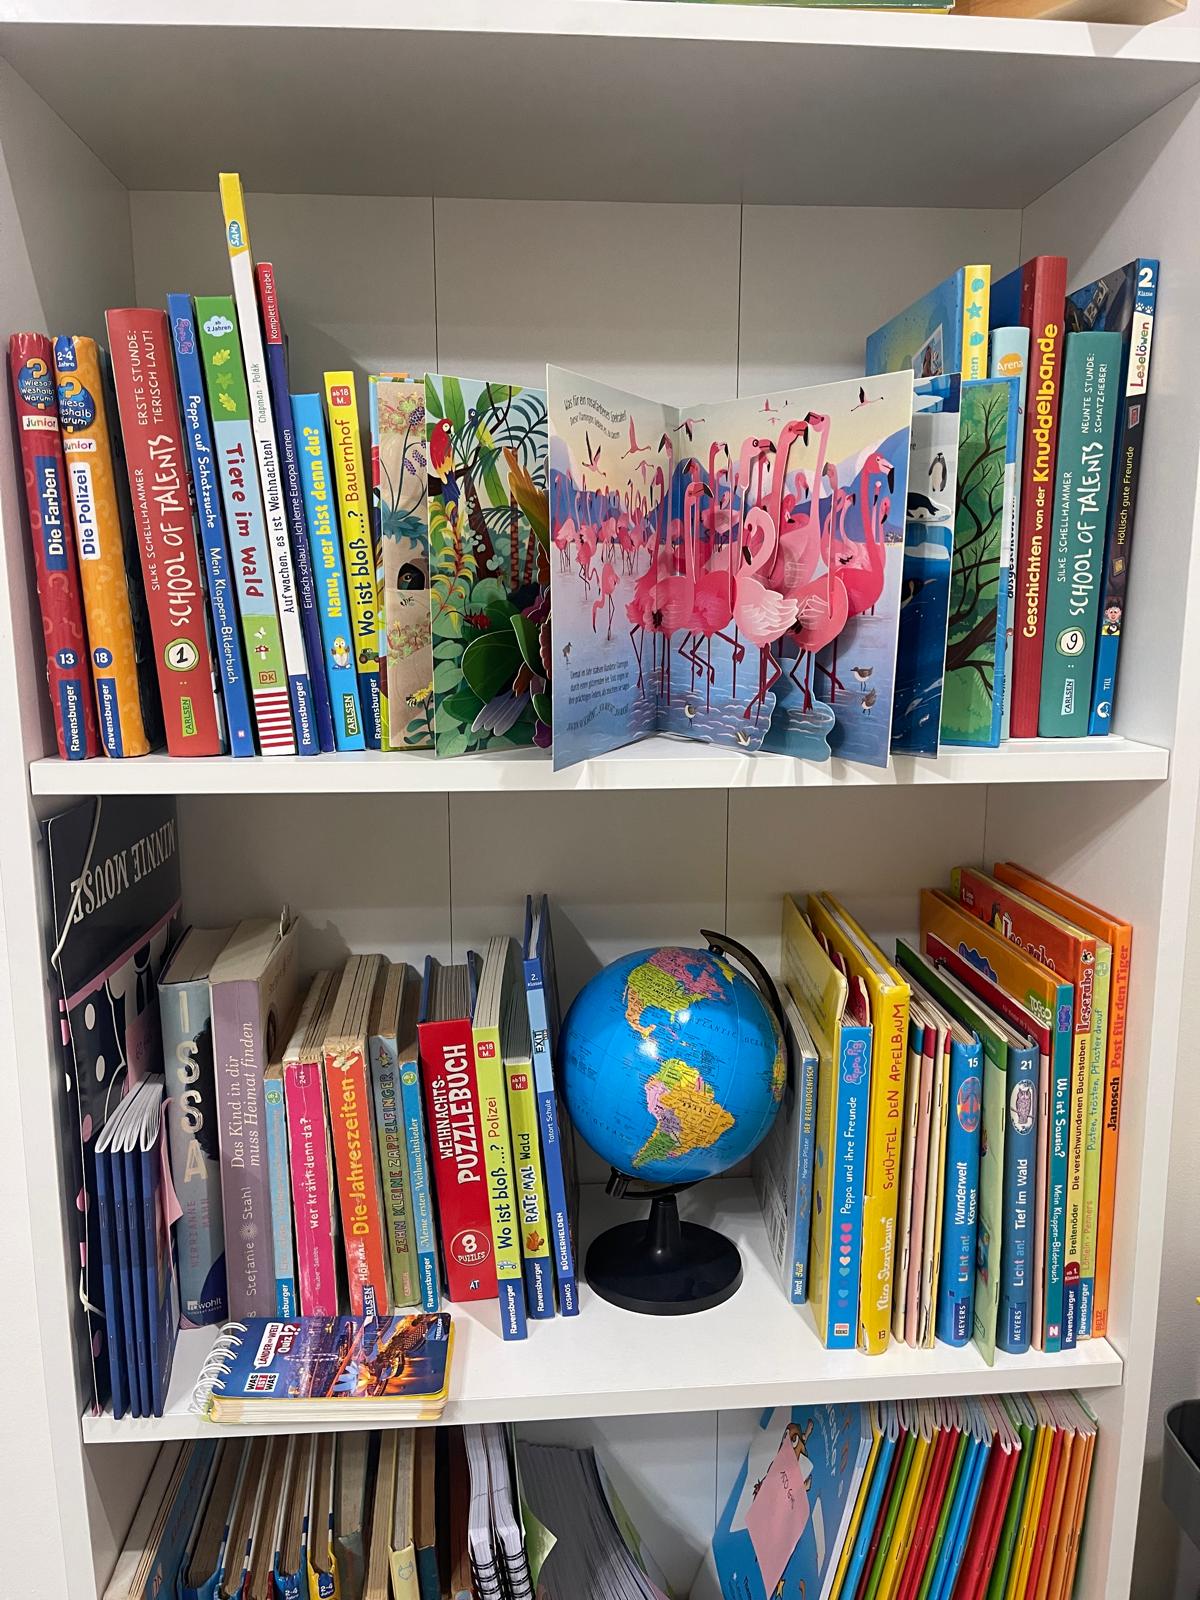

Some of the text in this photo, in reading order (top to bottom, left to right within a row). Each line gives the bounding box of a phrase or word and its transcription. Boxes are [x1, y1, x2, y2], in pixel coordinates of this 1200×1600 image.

[211, 324, 232, 332] Jahren
[264, 269, 278, 340] Komplett in Farbe!
[127, 329, 148, 426] ERSTE STUNDE:
[142, 330, 163, 425] TIERISCH LAUT!
[997, 359, 1024, 371] Arena
[1130, 322, 1150, 388] Leselöwen
[252, 390, 267, 423] Chapman
[1081, 353, 1095, 434] NEUNTE STUNDE:
[1095, 363, 1108, 434] SCHATZFIEBER!
[187, 395, 214, 528] Peppa auf Schatzsuche
[260, 440, 285, 547] es ist Weihnachten!
[1023, 323, 1058, 638] Geschichten von der Knuddelbande
[42, 468, 63, 555] Die Farben
[73, 469, 96, 555] Die Polizei
[135, 468, 160, 590] SILKE SCHELLHAMMER
[226, 442, 264, 597] Tiere im Wald
[284, 429, 313, 609] Einfach schlau! Ich lerne Europa kennen
[303, 427, 343, 617] Nanu, wer bist denn du?
[335, 420, 375, 637] Wo ist Bauernhof
[1057, 471, 1073, 583] SILKE SCHELLHAMMER
[1070, 441, 1105, 616] SCHOOL OF TALENTS
[1117, 446, 1134, 545] Höllisch gute Freunde
[148, 434, 196, 627] SCHOOL OF TALENTS
[210, 547, 239, 684] Mein Klappen-Bilderbuch
[59, 653, 75, 665] 13
[95, 652, 108, 663] 18
[261, 673, 275, 682] DK
[66, 684, 80, 751] Ravensburger
[101, 683, 116, 750] Ravensburger
[182, 698, 194, 736] CARLSEN
[296, 681, 311, 745] Ravensburger
[345, 695, 357, 734] CARLSEN
[370, 679, 381, 739] Ravensburger
[1064, 680, 1074, 714] CARLSEN
[71, 820, 176, 924] MINNIE MOUSE
[1077, 969, 1093, 1033] Leserabe
[534, 1030, 545, 1053] EXIT
[845, 1042, 863, 1083] Peppa Pig
[888, 1003, 906, 1118] DEN APFELBAUM
[967, 1058, 978, 1068] 15
[1021, 1061, 1031, 1070] 21
[1077, 1040, 1086, 1094] Buchstaben
[1091, 1042, 1101, 1075] Pflaster
[1107, 946, 1128, 1132] Janosch Post für den Tiger
[226, 1055, 245, 1169] Das Kind in dir
[239, 1021, 260, 1166] muss Heimat finden
[380, 1072, 402, 1167] ZAPPELFINGER
[432, 1075, 453, 1159] WEIHNACHTS-
[443, 1044, 480, 1184] PUZZLEBUCH
[545, 1099, 553, 1121] Schule
[805, 1066, 814, 1121] REGENBOGENFISCH
[1056, 1078, 1068, 1116] Wo ist
[340, 1078, 370, 1235] Die Jahreszeiten
[409, 1118, 428, 1218] ersten Weihnachtslieder
[840, 1096, 857, 1214] Peppa und ihre Freunde
[1074, 1096, 1083, 1174] verschwundenen
[303, 1143, 319, 1229] Wer denn
[390, 1170, 406, 1216] KLEINE
[486, 1097, 512, 1249] Wo ist Polizei
[518, 1133, 538, 1224] RATE MAL Wald
[954, 1162, 968, 1225] Wunderwelt
[968, 1188, 976, 1224] Körper
[241, 1187, 257, 1296] Stefanie Stahl
[394, 1222, 408, 1253] ZEHN
[462, 1234, 478, 1248] 8
[556, 1212, 569, 1271] BÜCHERHELDEN
[1013, 1159, 1028, 1287] Licht Tief im Wald
[1050, 1184, 1063, 1284] Mein Klappen-Bilderbuch
[1070, 1203, 1079, 1255] Breitenöder
[424, 1257, 434, 1308] Ravensburger
[458, 1252, 485, 1262] PUZZLES
[533, 1263, 544, 1312] Ravensburger
[505, 1284, 517, 1334] Ravensburger
[958, 1304, 966, 1336] MEYERS
[1013, 1309, 1022, 1342] MEYERS
[1065, 1290, 1074, 1343] Ravensburger
[1078, 1284, 1089, 1335] Ravensburger
[246, 1374, 258, 1390] WAS
[265, 1374, 276, 1390] WAS
